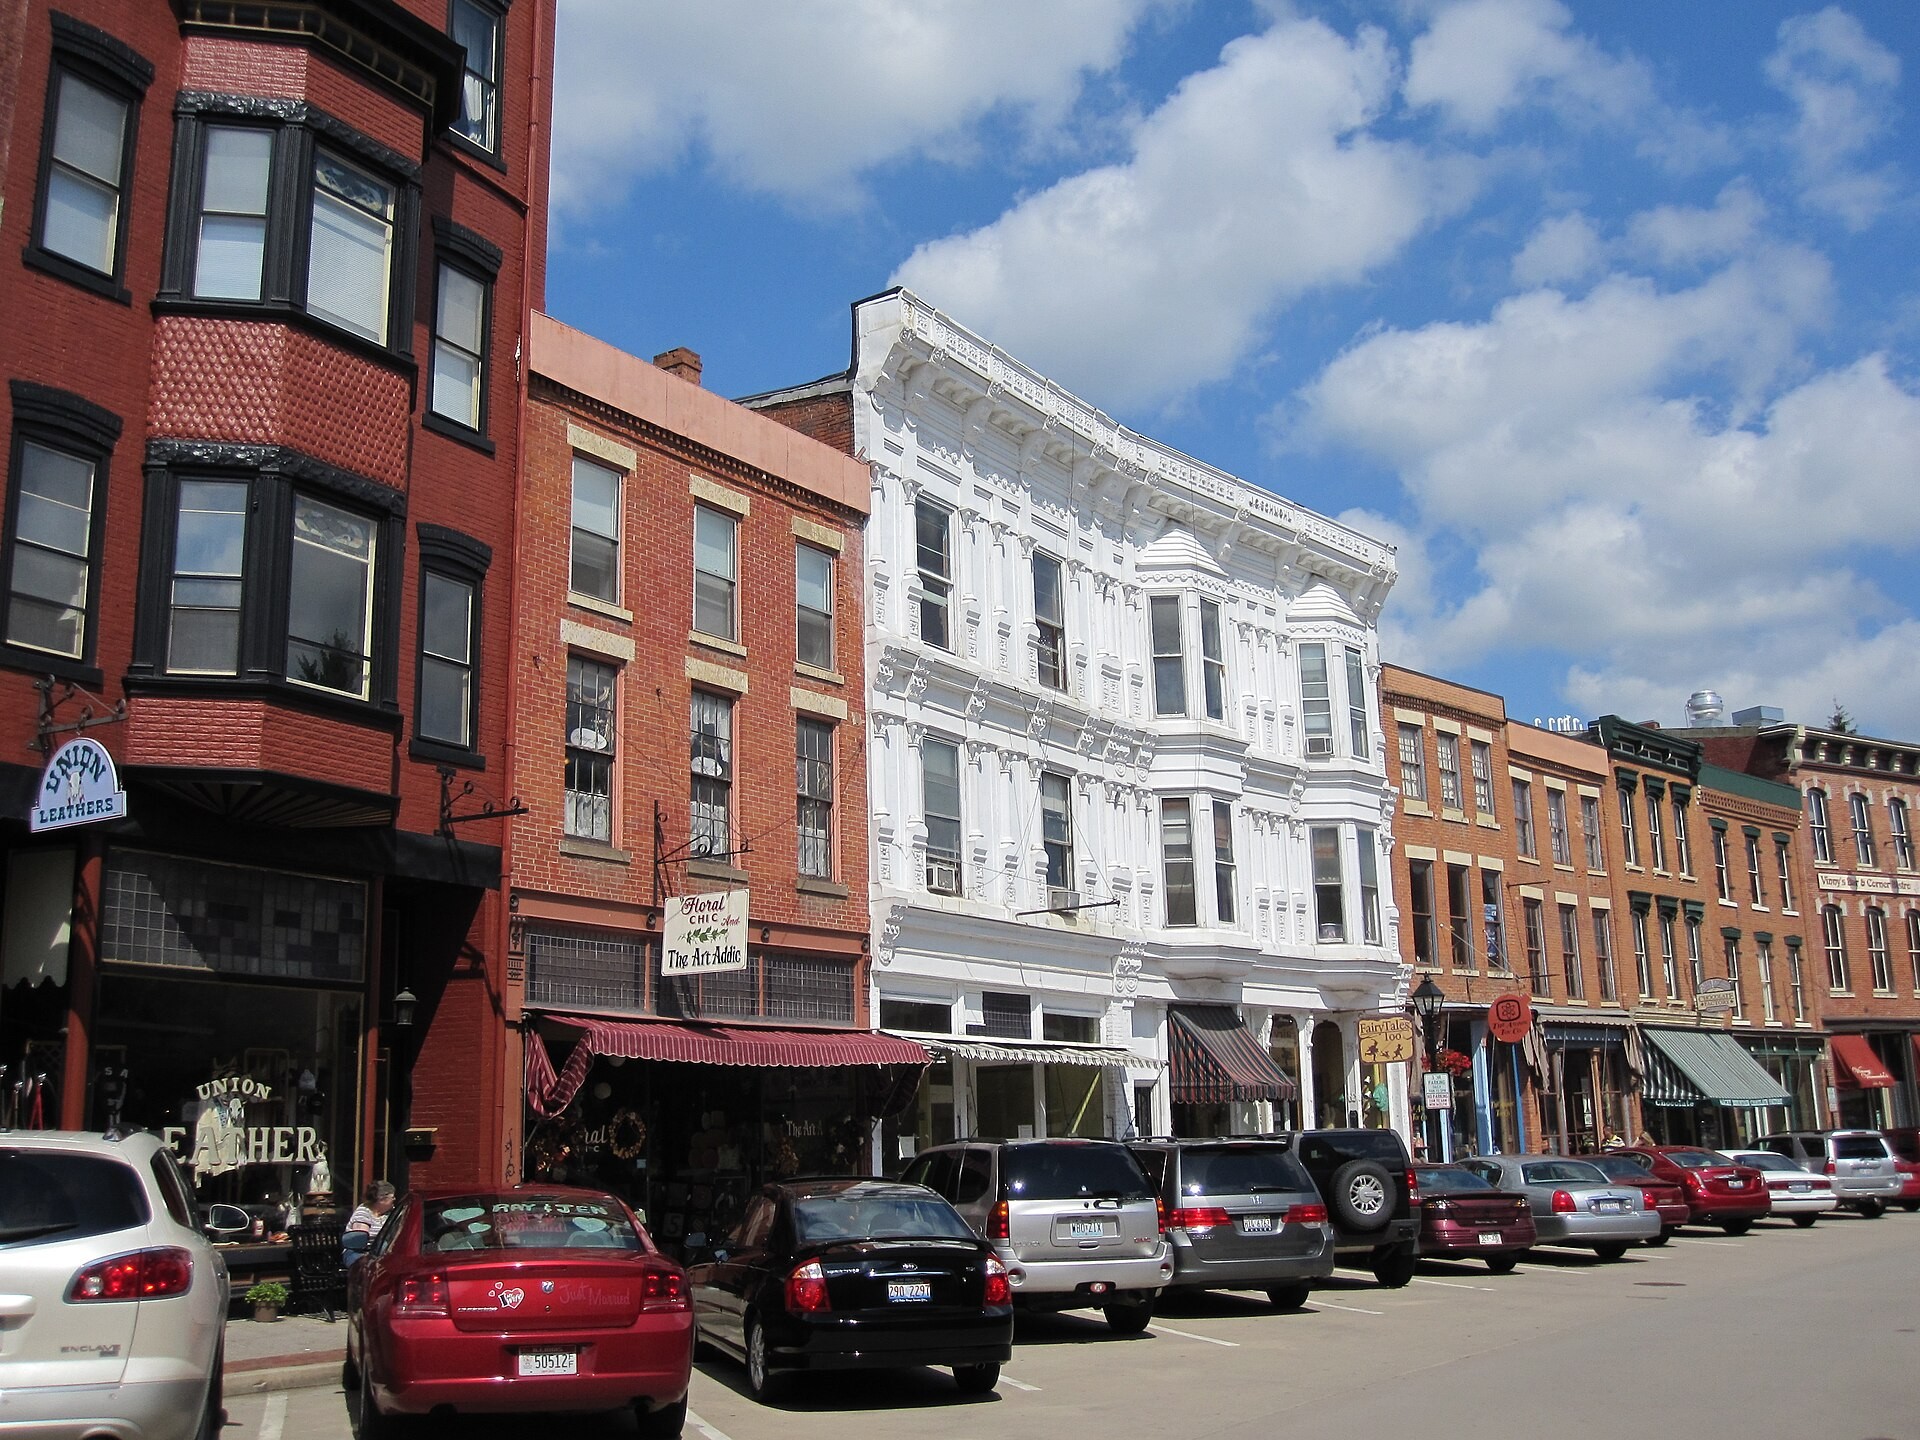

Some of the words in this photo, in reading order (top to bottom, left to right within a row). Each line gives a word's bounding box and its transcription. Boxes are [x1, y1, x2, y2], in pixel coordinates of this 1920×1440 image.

[46, 745, 106, 793] UNION
[40, 798, 114, 823] LEATHERS
[681, 896, 725, 915] Floral
[689, 913, 719, 925] CHIC
[668, 949, 688, 969] The
[692, 947, 711, 966] Art
[712, 945, 741, 965] Addic
[1384, 1032, 1402, 1041] Too
[196, 1077, 272, 1100] UNION
[163, 1126, 318, 1165] EATHER
[493, 1203, 536, 1213] RAY
[555, 1204, 608, 1215] JEN
[559, 1282, 589, 1304] Just
[889, 1285, 904, 1298] 290
[534, 1354, 568, 1369] 50512
